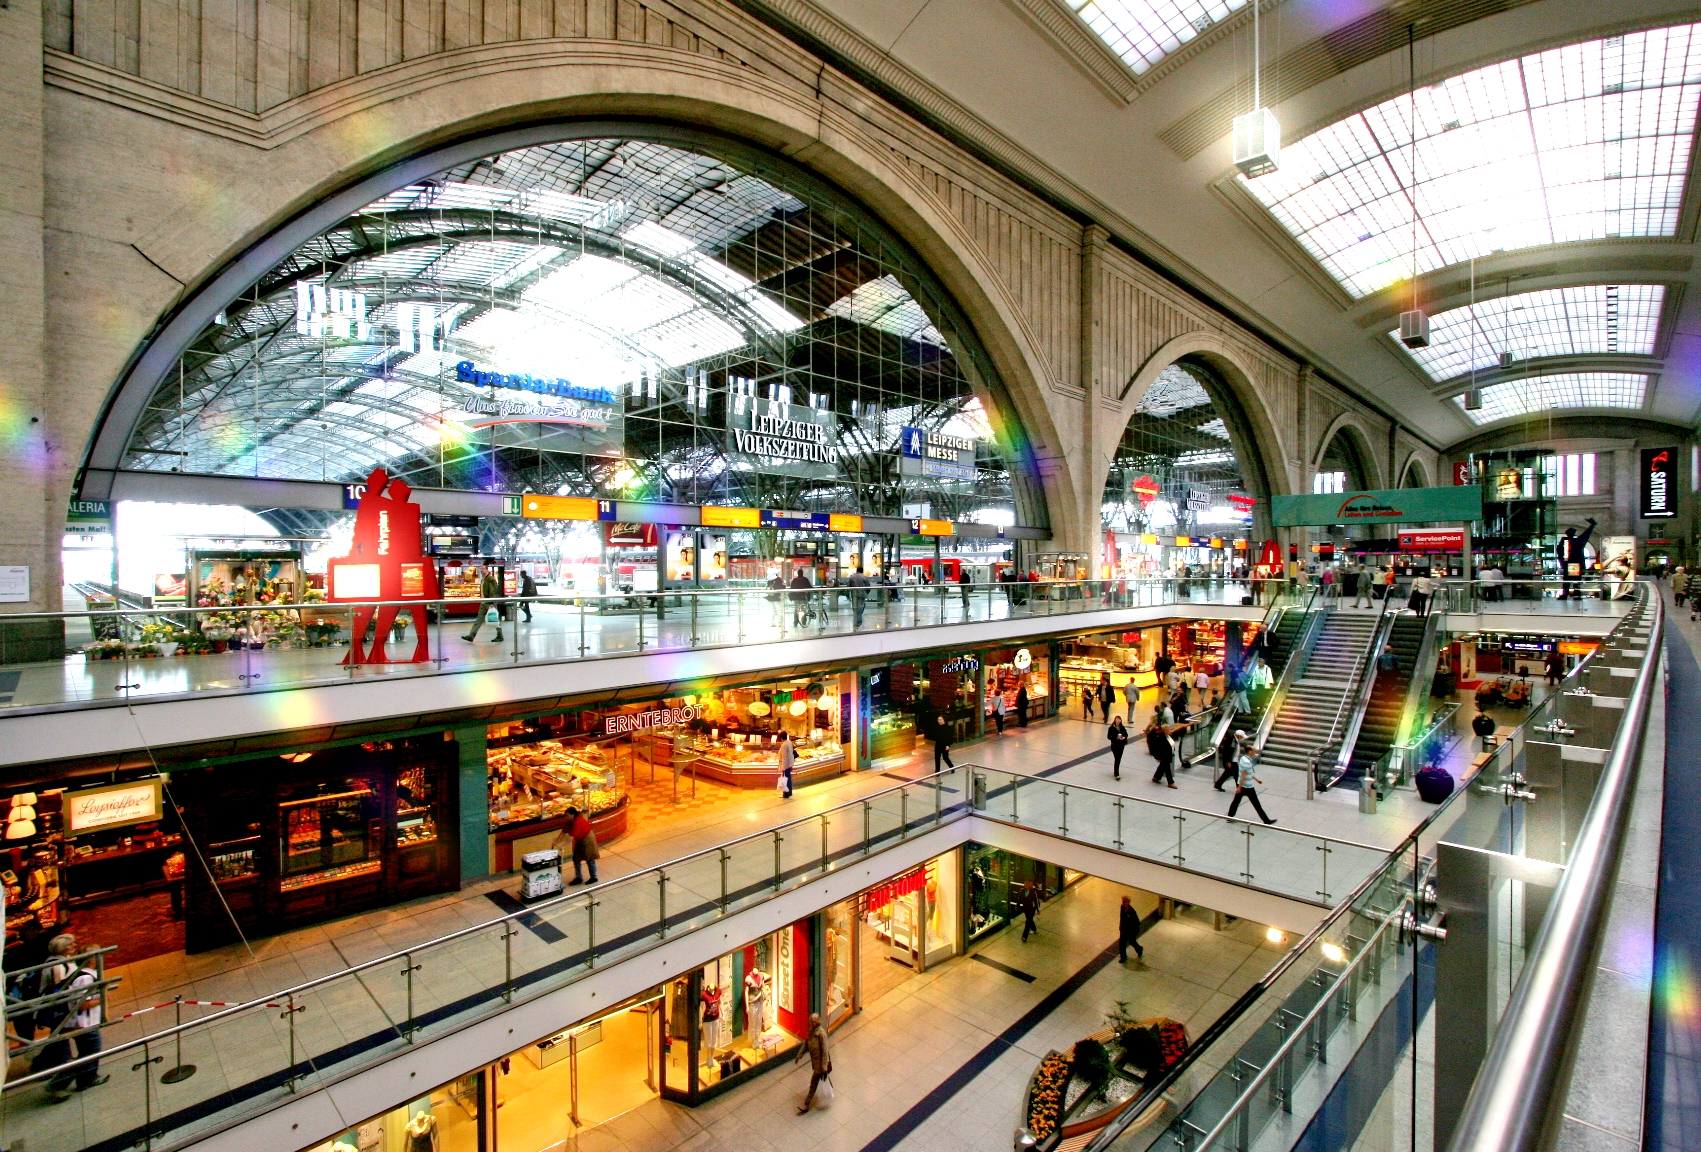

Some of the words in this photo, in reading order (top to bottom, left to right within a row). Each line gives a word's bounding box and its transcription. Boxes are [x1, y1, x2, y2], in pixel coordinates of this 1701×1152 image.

[457, 360, 615, 403] Sparda-Bank
[464, 396, 496, 413] Uns
[500, 399, 547, 419] finden
[547, 401, 577, 417] Sie
[580, 407, 602, 421] gut
[750, 409, 825, 442] LEIPZIGER
[733, 428, 837, 463] VOLKSZEITUNG
[928, 433, 973, 451] LEIPZIGER
[928, 446, 958, 461] MESSE
[346, 485, 366, 500] 10
[1651, 471, 1666, 510] SATURN
[599, 500, 610, 513] 11
[377, 510, 391, 555] Fahrplan
[911, 519, 919, 530] 12
[606, 704, 703, 735] ERNTEBROT
[78, 794, 150, 817] Leysieffer
[780, 928, 790, 959] One
[780, 960, 790, 1010] Street
